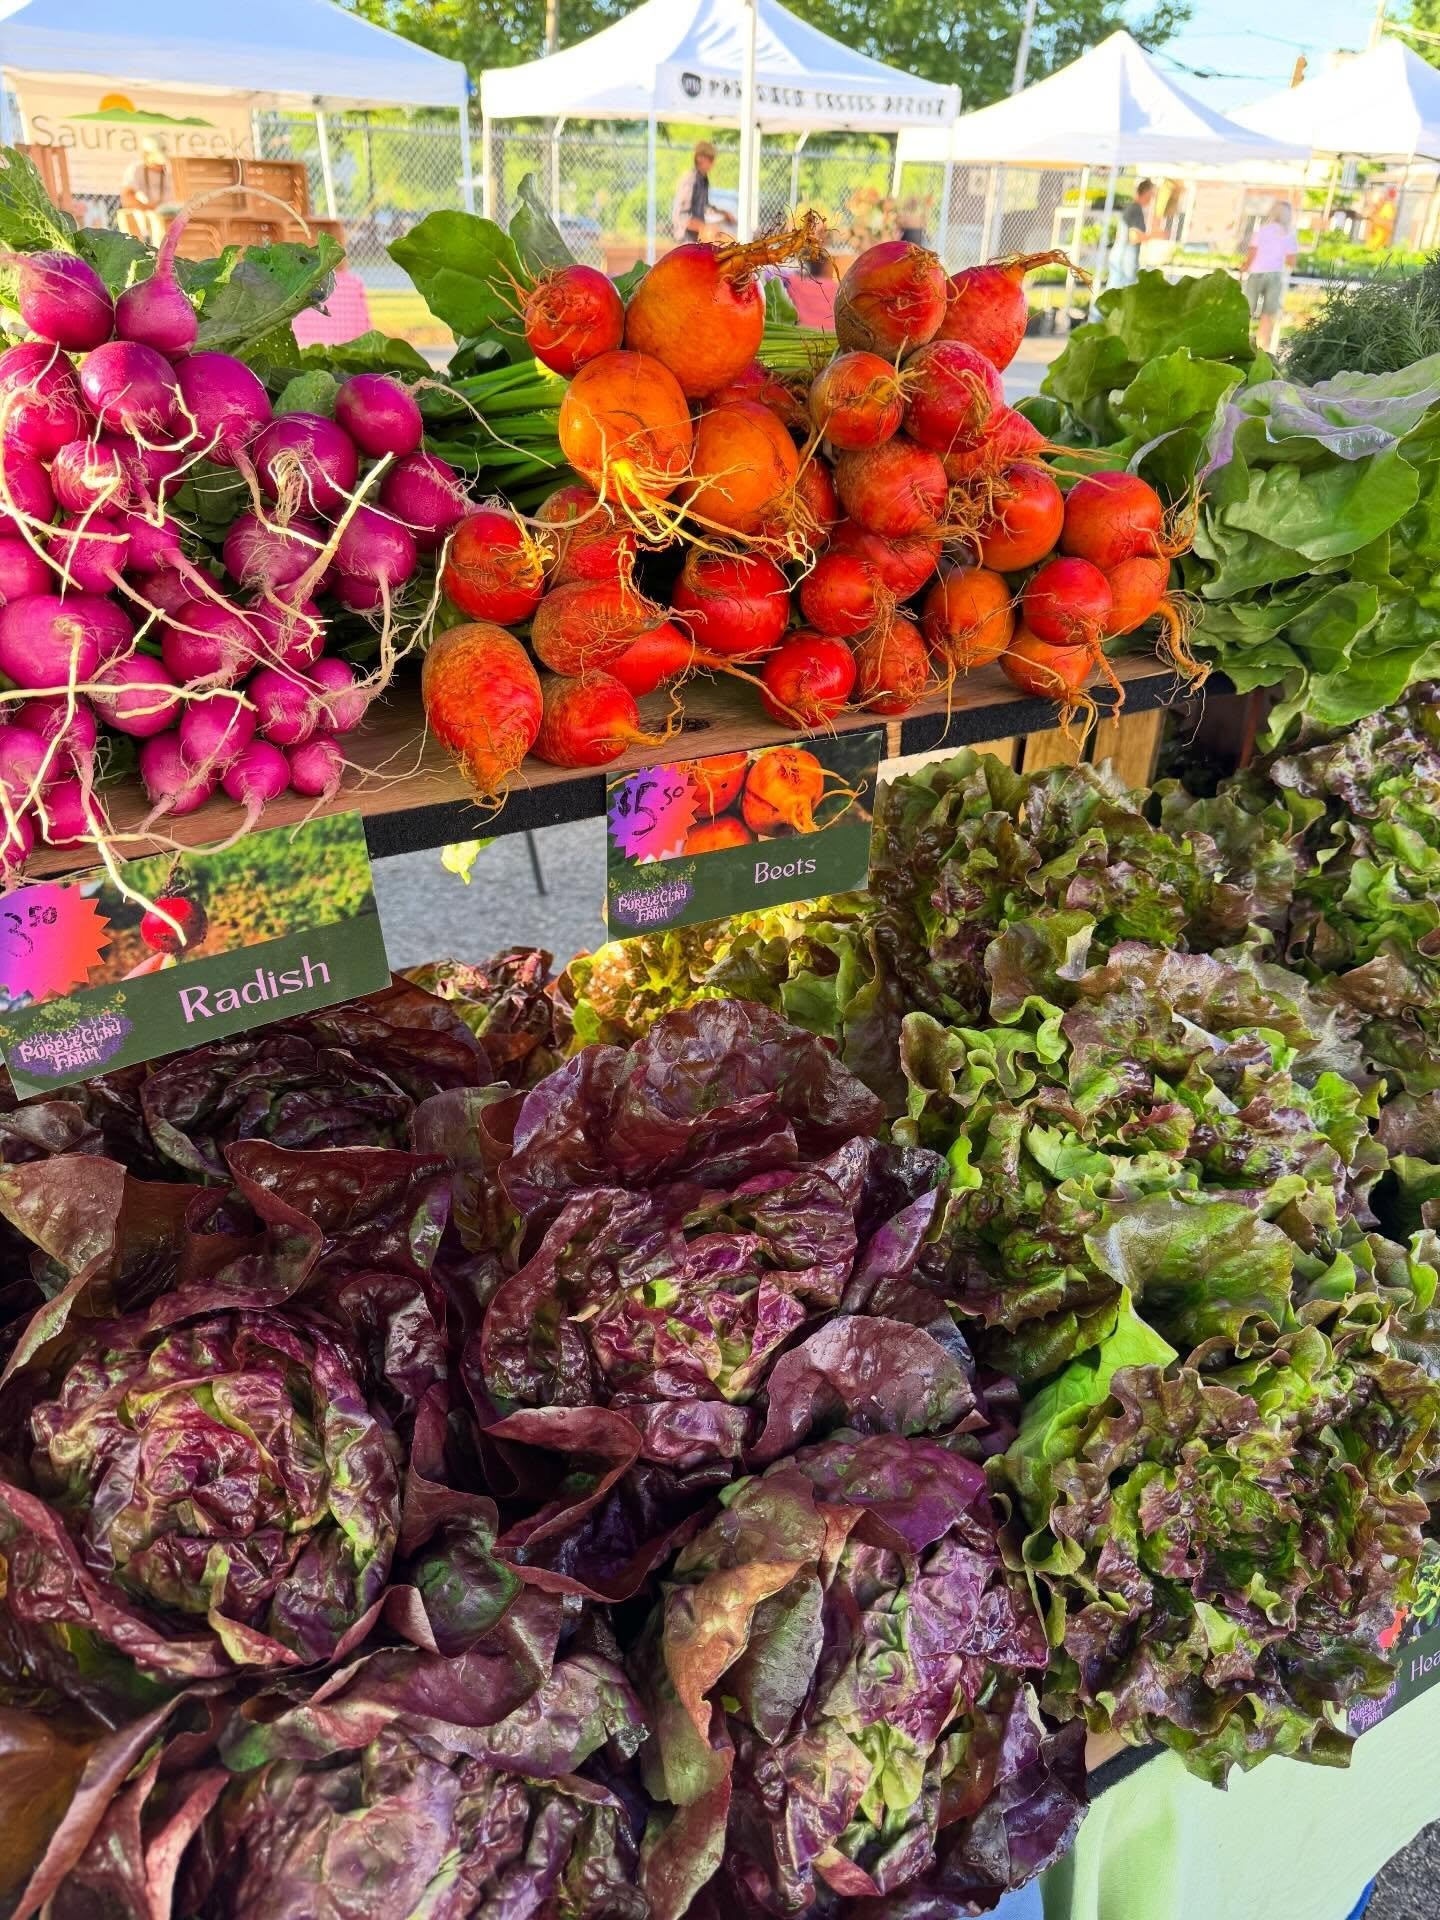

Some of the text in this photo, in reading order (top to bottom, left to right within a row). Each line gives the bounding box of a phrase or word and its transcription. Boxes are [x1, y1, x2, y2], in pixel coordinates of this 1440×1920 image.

[31, 115, 138, 151] Saura
[754, 858, 817, 885] Beets
[618, 893, 660, 913] PURPLE
[636, 905, 669, 924] FARM
[178, 955, 331, 1024] Radish
[18, 1034, 83, 1063] PURPLE
[53, 1044, 101, 1073] FARM
